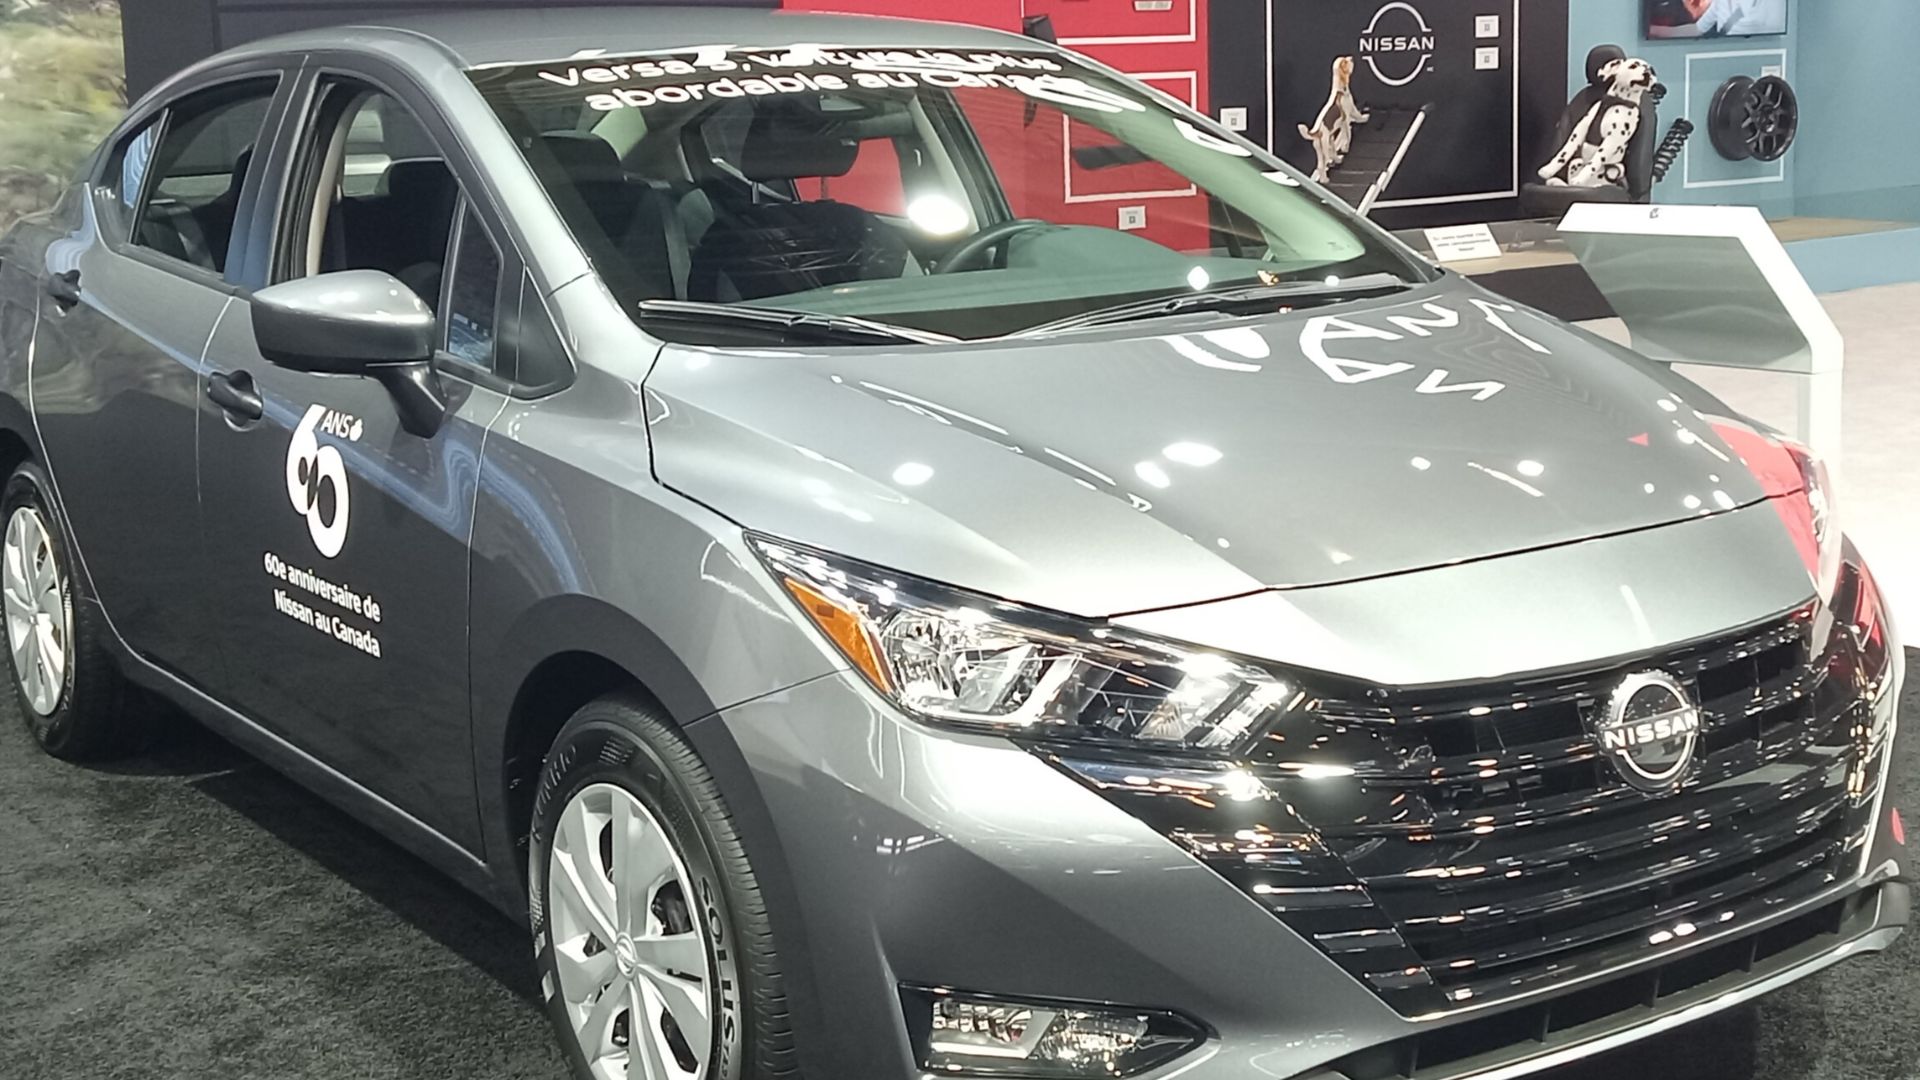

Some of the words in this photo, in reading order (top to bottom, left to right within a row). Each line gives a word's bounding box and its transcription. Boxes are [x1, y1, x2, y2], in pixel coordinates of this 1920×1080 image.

[538, 60, 697, 87] Versa
[966, 53, 1063, 71] plus
[1360, 36, 1434, 52] NISSAN
[585, 72, 848, 111] abordable
[852, 73, 918, 88] au
[286, 404, 350, 558] 60
[321, 409, 353, 438] ANS
[264, 551, 287, 581] 60e
[288, 569, 362, 615] anniversaire
[363, 595, 382, 623] de
[273, 588, 314, 627] Nissan
[315, 611, 331, 635] au
[332, 616, 382, 658] Canada
[1604, 709, 1699, 749] NISSAN
[700, 877, 736, 1044] SOLUS
